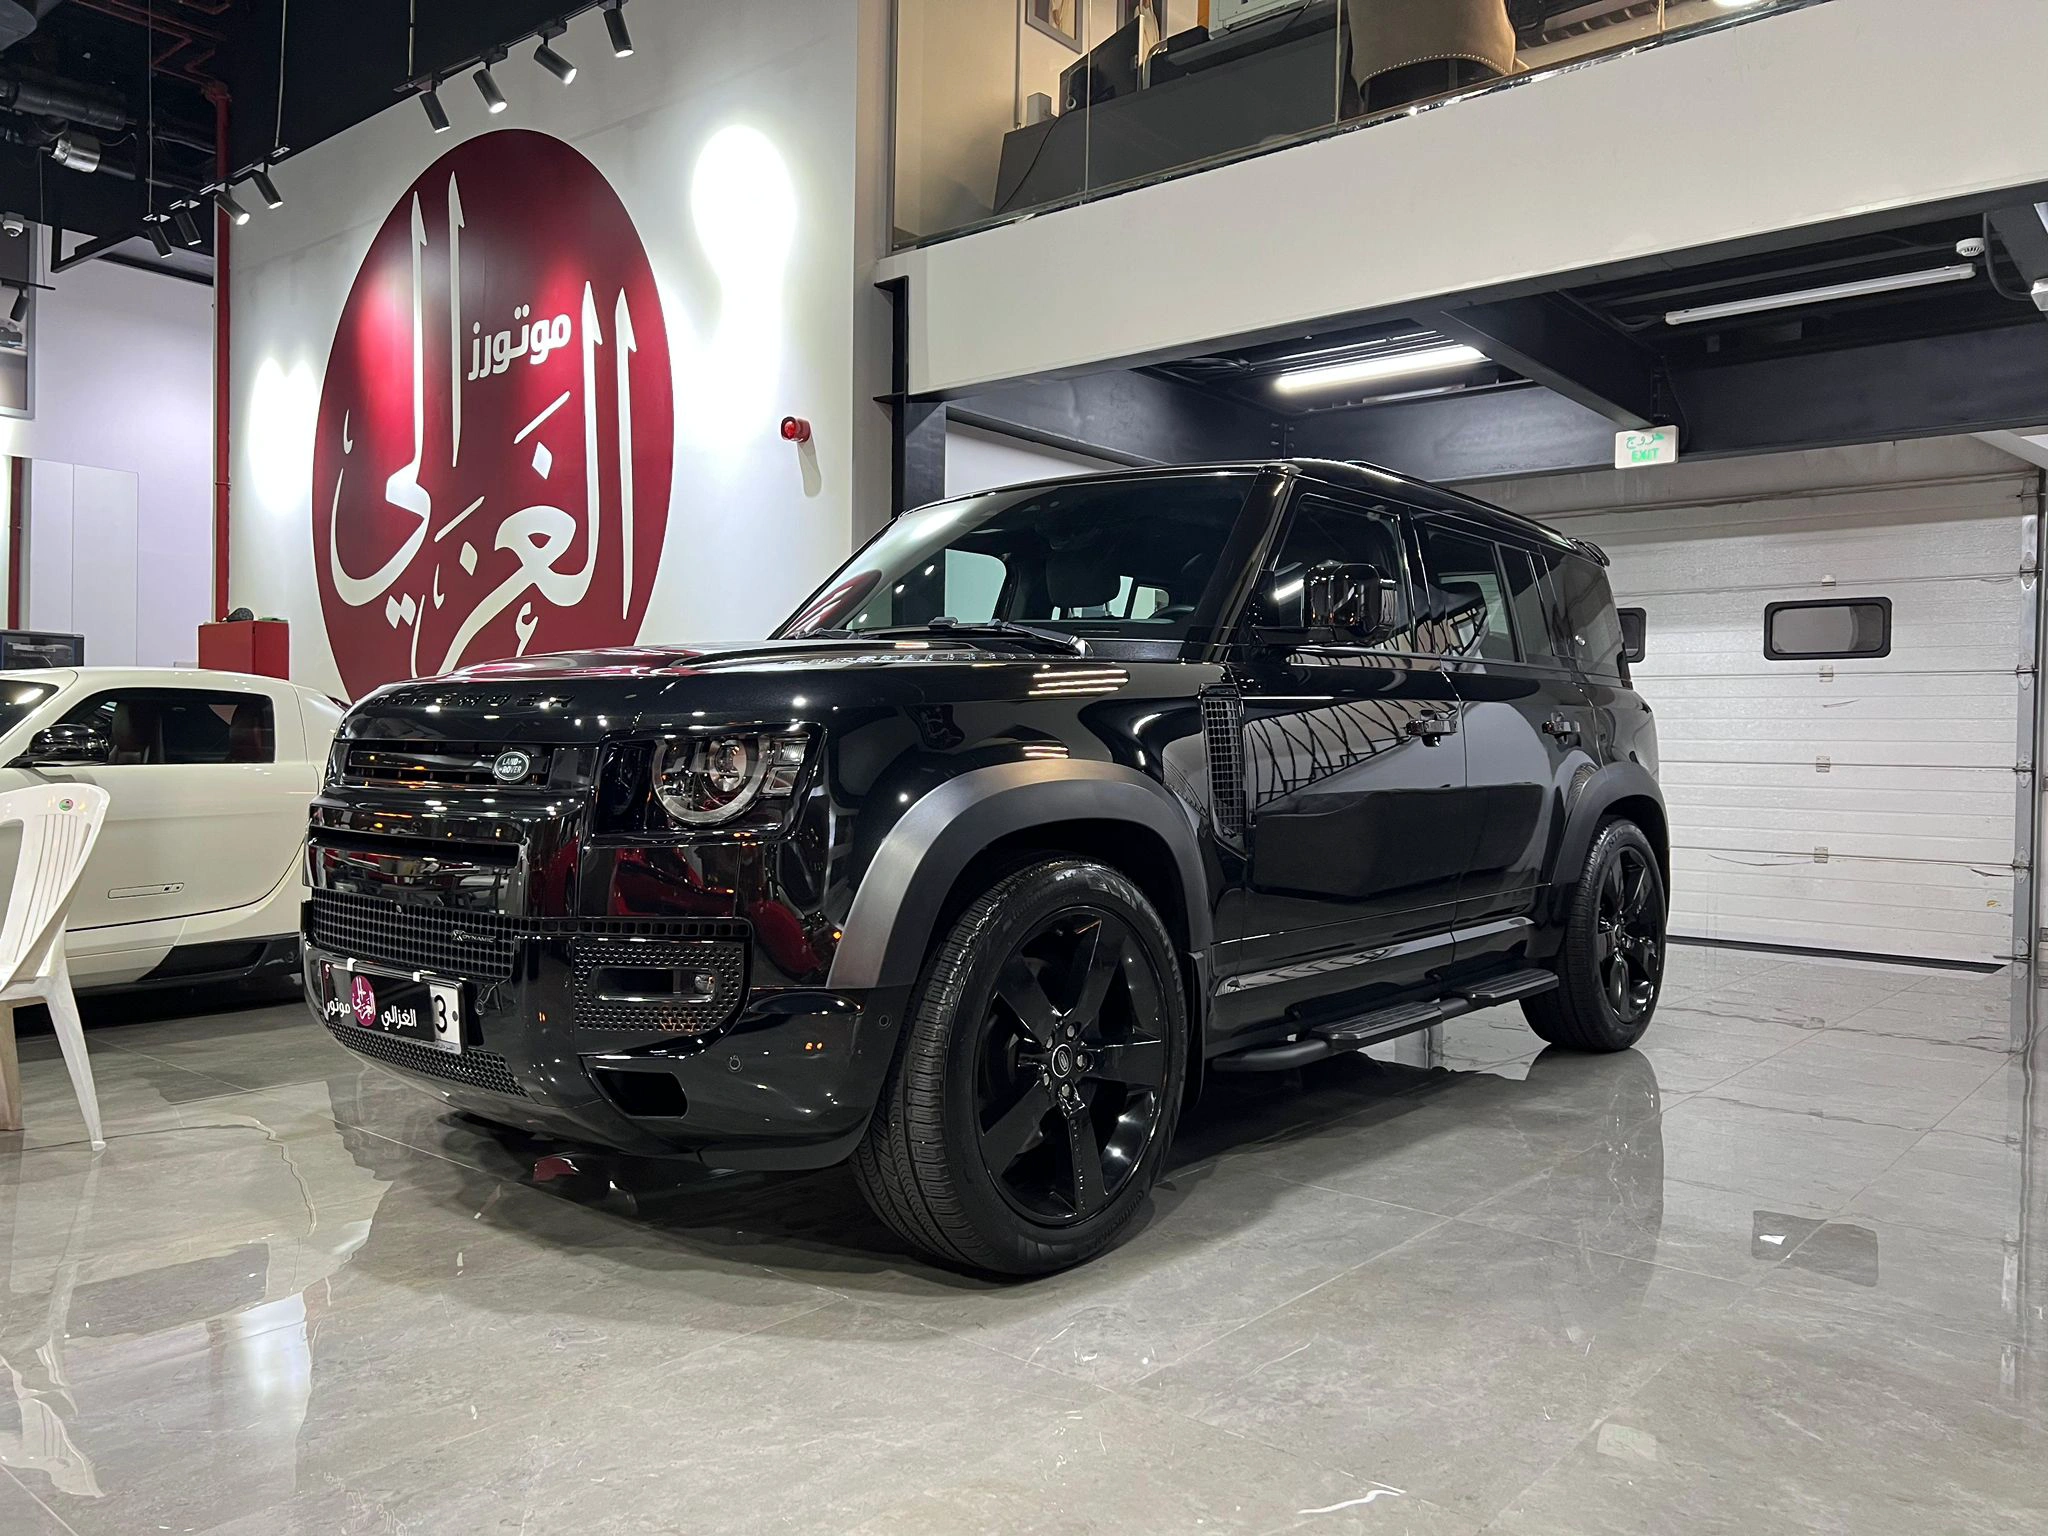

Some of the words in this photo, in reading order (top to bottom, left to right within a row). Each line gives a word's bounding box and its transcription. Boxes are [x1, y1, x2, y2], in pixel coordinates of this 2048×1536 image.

[467, 304, 572, 381] موتورز
[1626, 433, 1665, 450] خروج
[1631, 447, 1660, 463] EXIT
[381, 1004, 418, 1031] الغزالي
[433, 994, 448, 1034] 3
